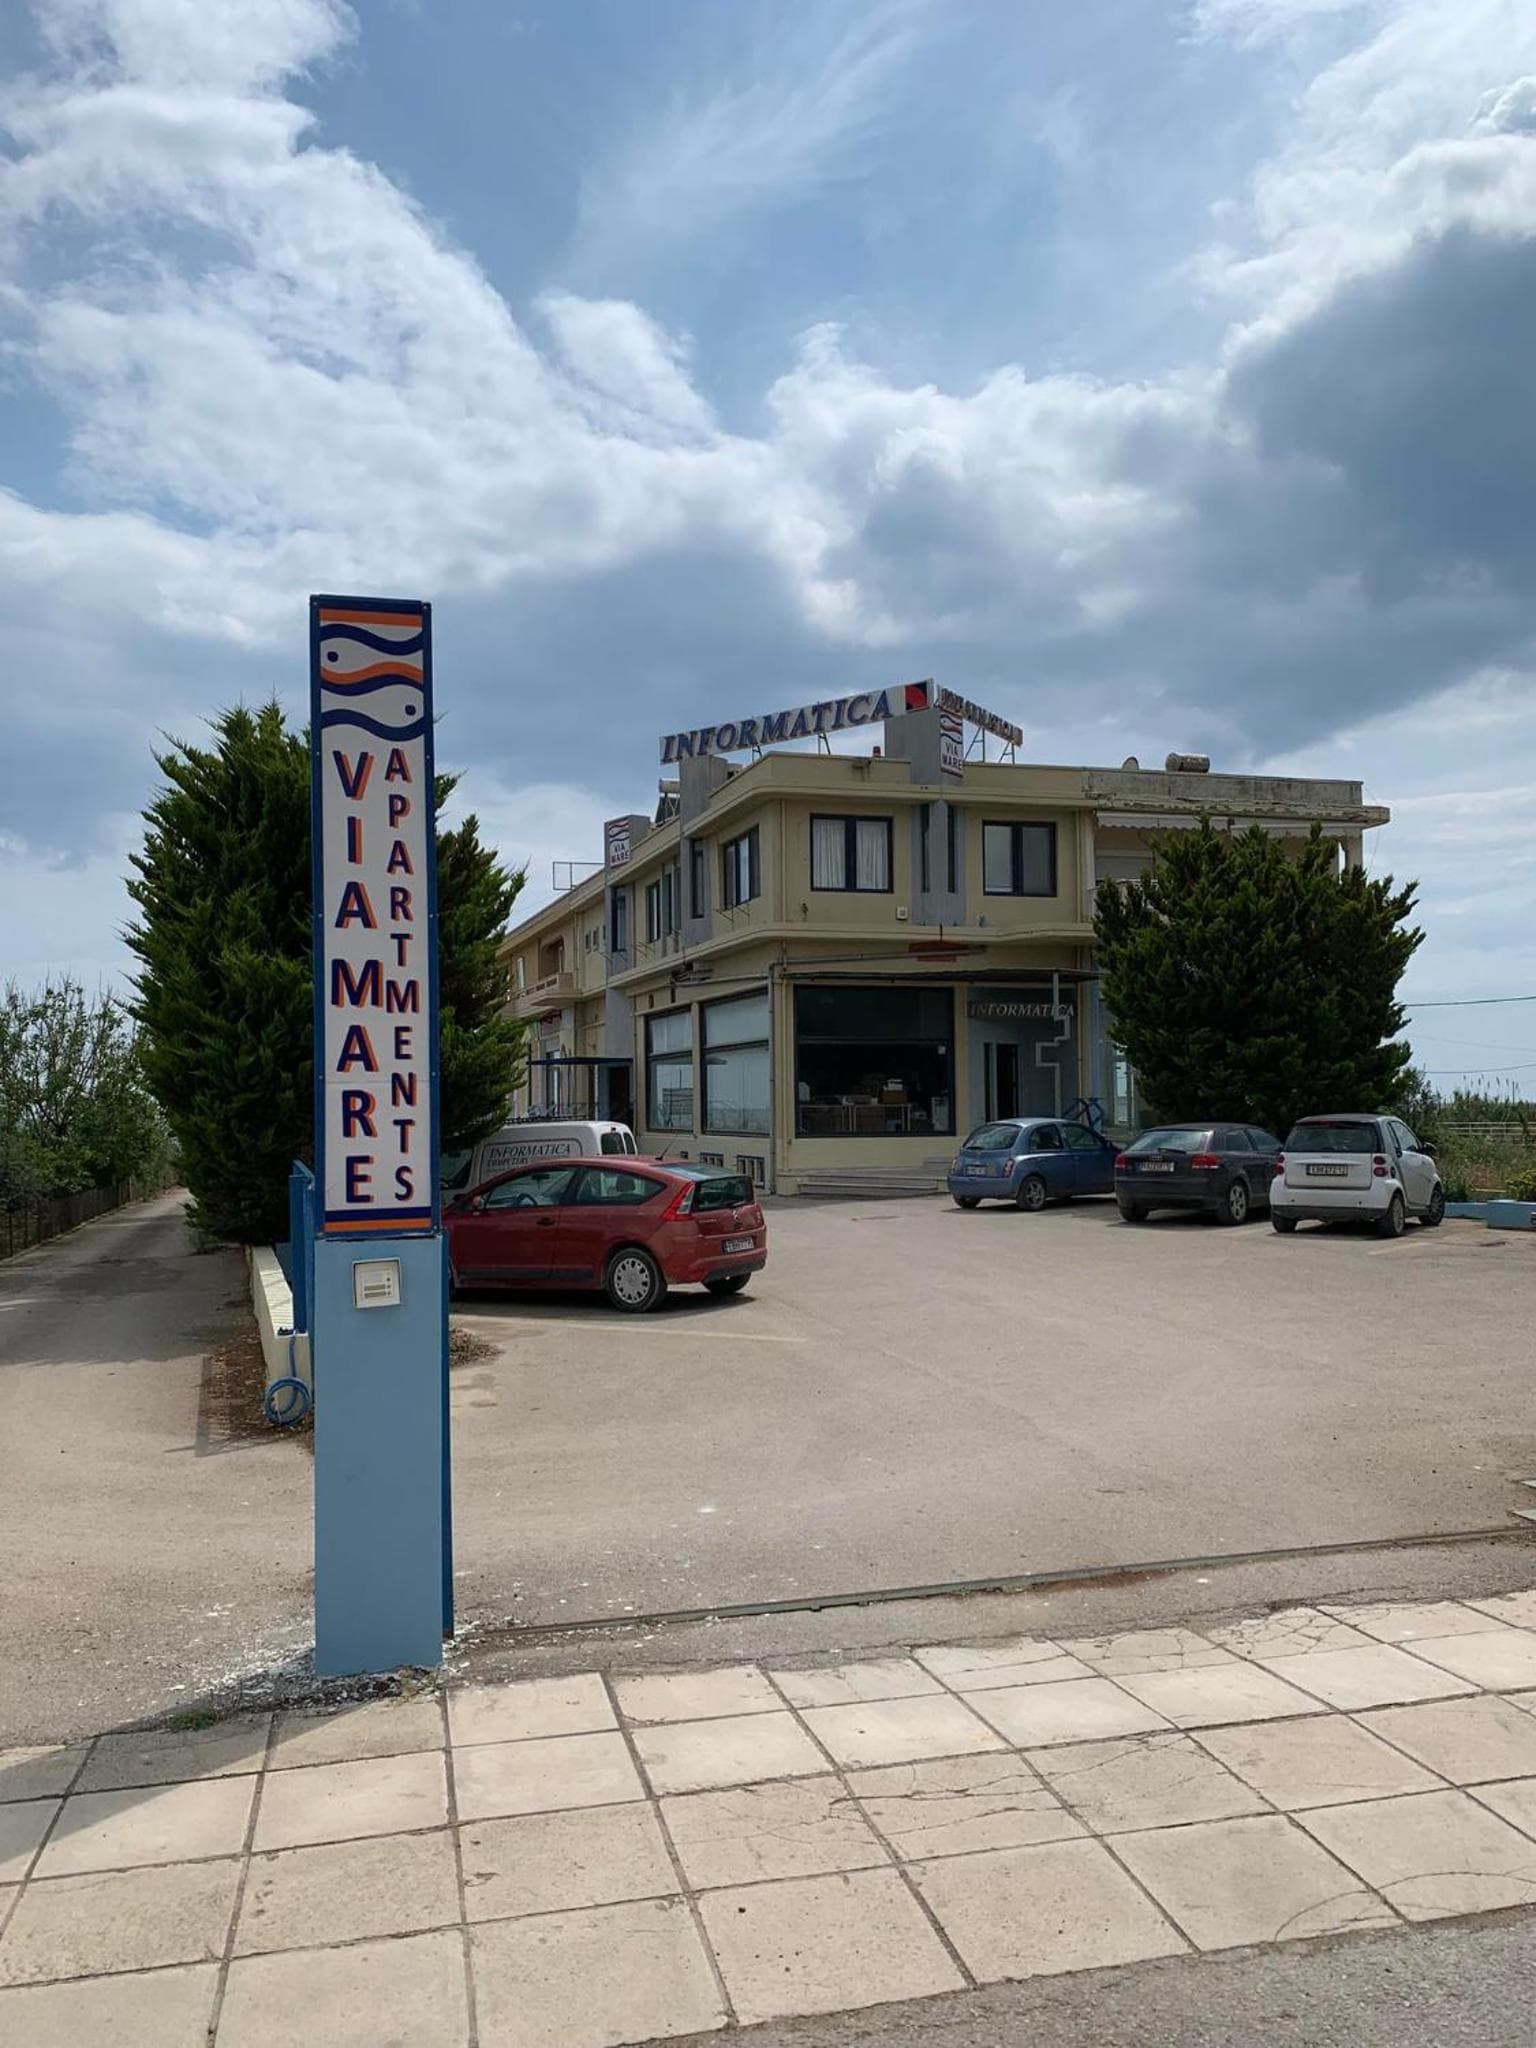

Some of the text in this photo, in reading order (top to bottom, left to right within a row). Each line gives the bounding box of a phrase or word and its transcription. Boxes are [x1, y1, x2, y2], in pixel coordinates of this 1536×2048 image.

[660, 690, 894, 764] INFORMATICA
[330, 750, 384, 1204] VIA MARE
[385, 747, 420, 1202] APARTMENTS
[971, 1003, 1074, 1017] INFORMATICA
[490, 1143, 570, 1159] INFORMATICA
